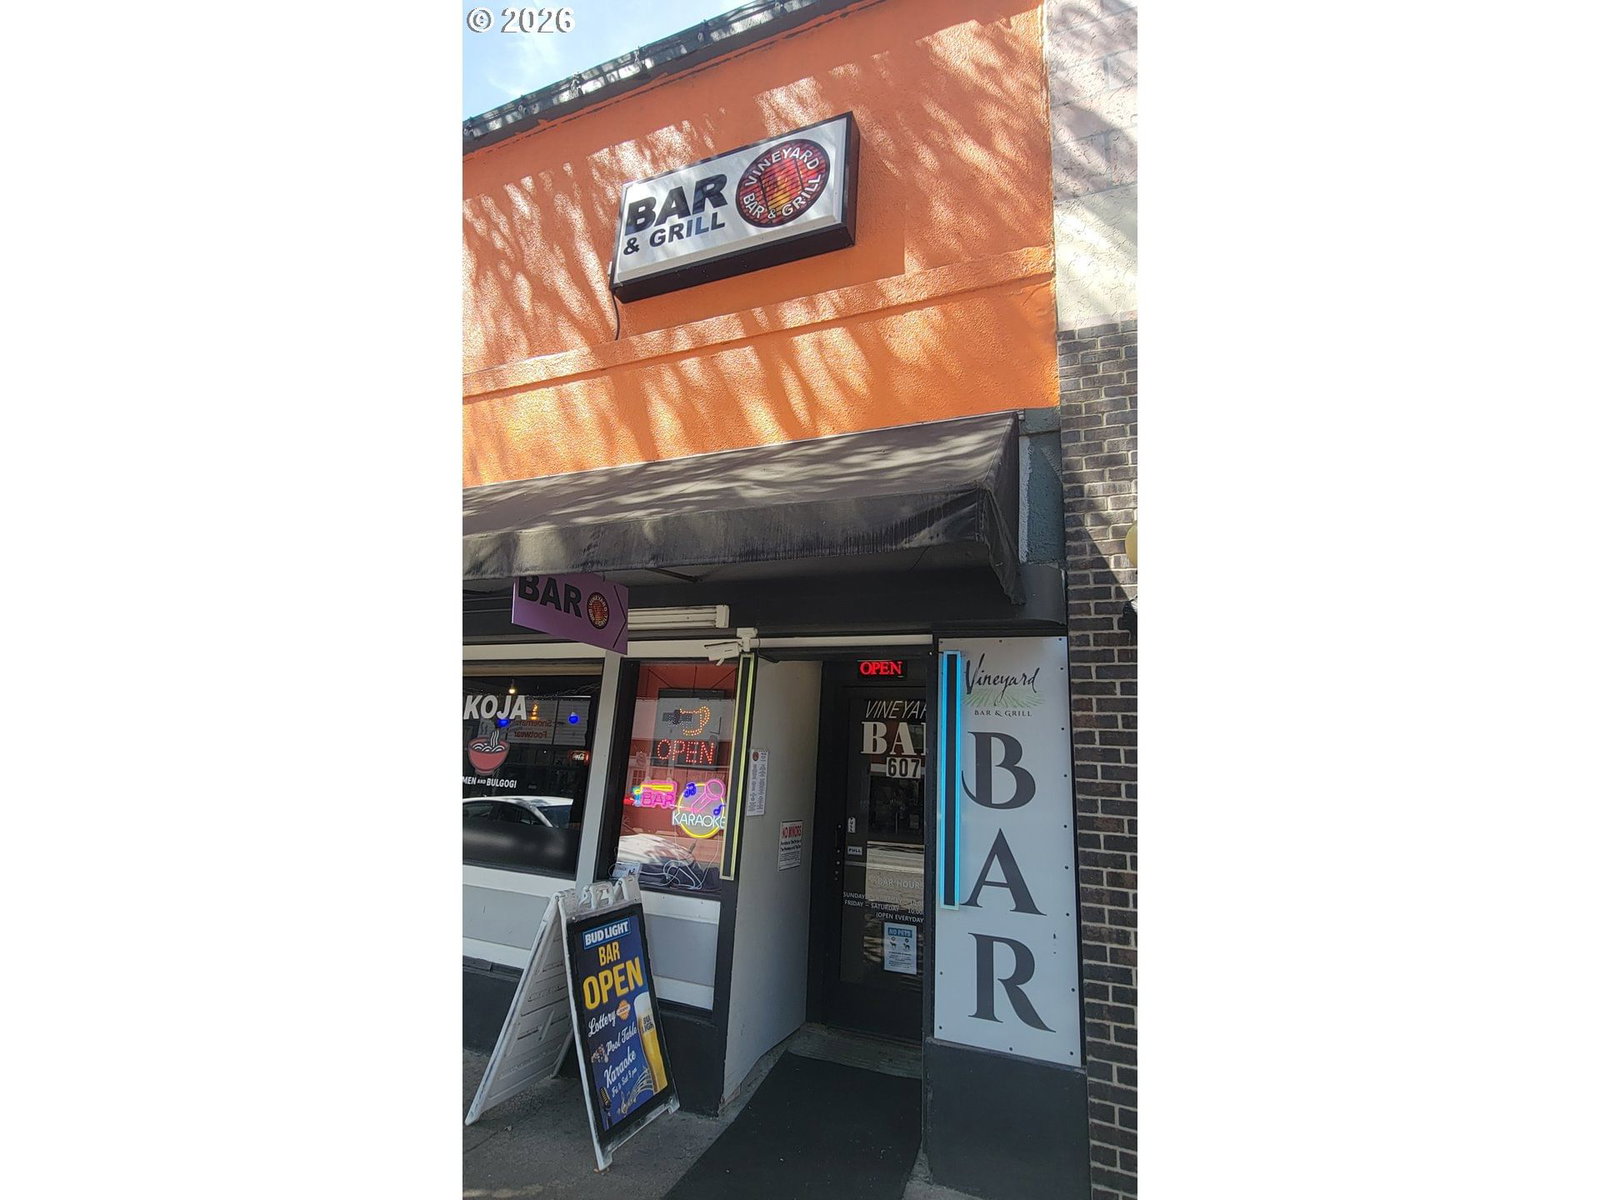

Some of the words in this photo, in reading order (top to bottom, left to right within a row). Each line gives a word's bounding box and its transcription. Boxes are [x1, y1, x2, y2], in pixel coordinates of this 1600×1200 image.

[744, 146, 820, 187] VINEYARD
[624, 174, 728, 236] BAR
[743, 192, 765, 219] BAR
[767, 208, 777, 219] &
[781, 174, 822, 217] GRILL
[623, 237, 640, 256] &
[649, 212, 726, 248] GRILL
[518, 575, 583, 618] BAR
[860, 661, 903, 675] OPEN
[965, 653, 1040, 705] Vineyard
[463, 694, 527, 720] KOJA
[657, 739, 715, 765] OPEN
[861, 721, 926, 756] BA
[887, 758, 920, 778] 607
[486, 778, 517, 788] BULGOGI
[642, 790, 676, 809] BAR
[672, 811, 726, 829] KARAOKE
[960, 731, 1057, 1033] BAR
[871, 903, 899, 912] SATURDAY
[895, 915, 924, 923] EVERYDAY
[585, 930, 604, 946] BUD
[604, 921, 629, 939] LIGHT
[598, 941, 620, 967] BAR
[583, 957, 643, 1010] OPEN
[588, 1010, 617, 1037] Lottery
[606, 1032, 620, 1055] Pool
[621, 1021, 638, 1043] Table
[604, 1046, 636, 1088] Karaoke
